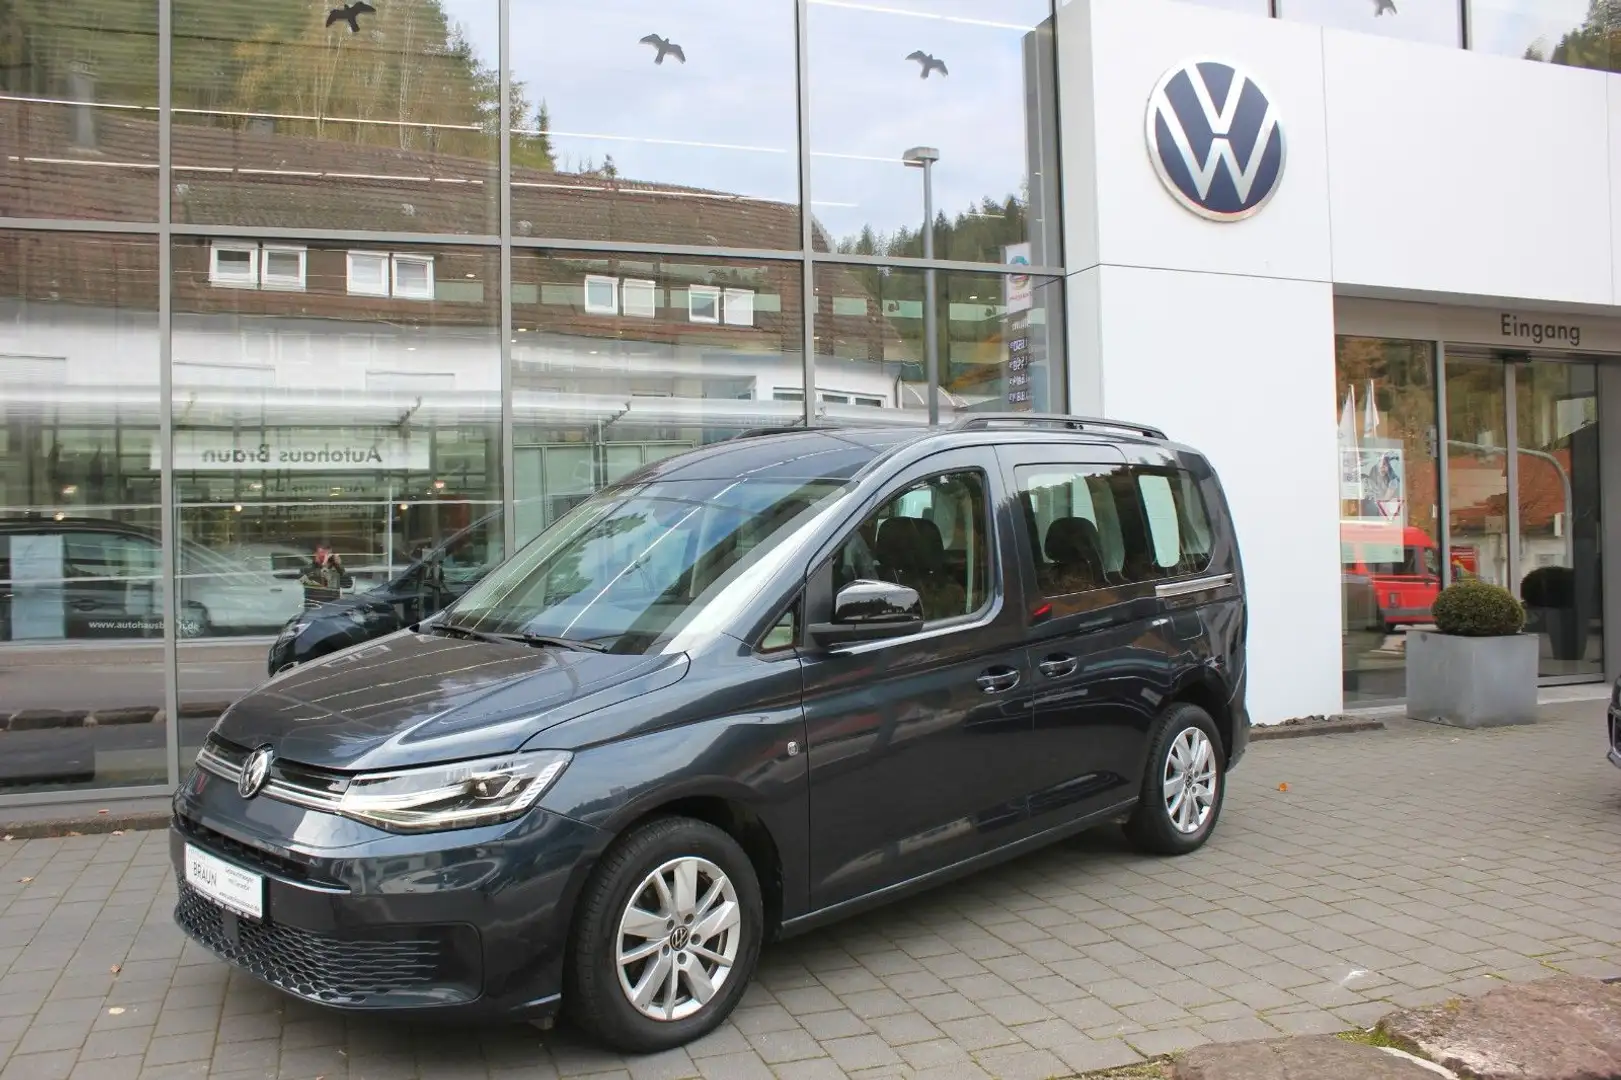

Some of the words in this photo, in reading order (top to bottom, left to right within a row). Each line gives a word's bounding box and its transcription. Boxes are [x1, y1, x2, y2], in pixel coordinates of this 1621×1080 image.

[1150, 59, 1283, 214] VW
[1501, 313, 1581, 347] Eingang
[88, 620, 200, 632] www.autohausbn.de
[193, 861, 218, 887] BRAUN
